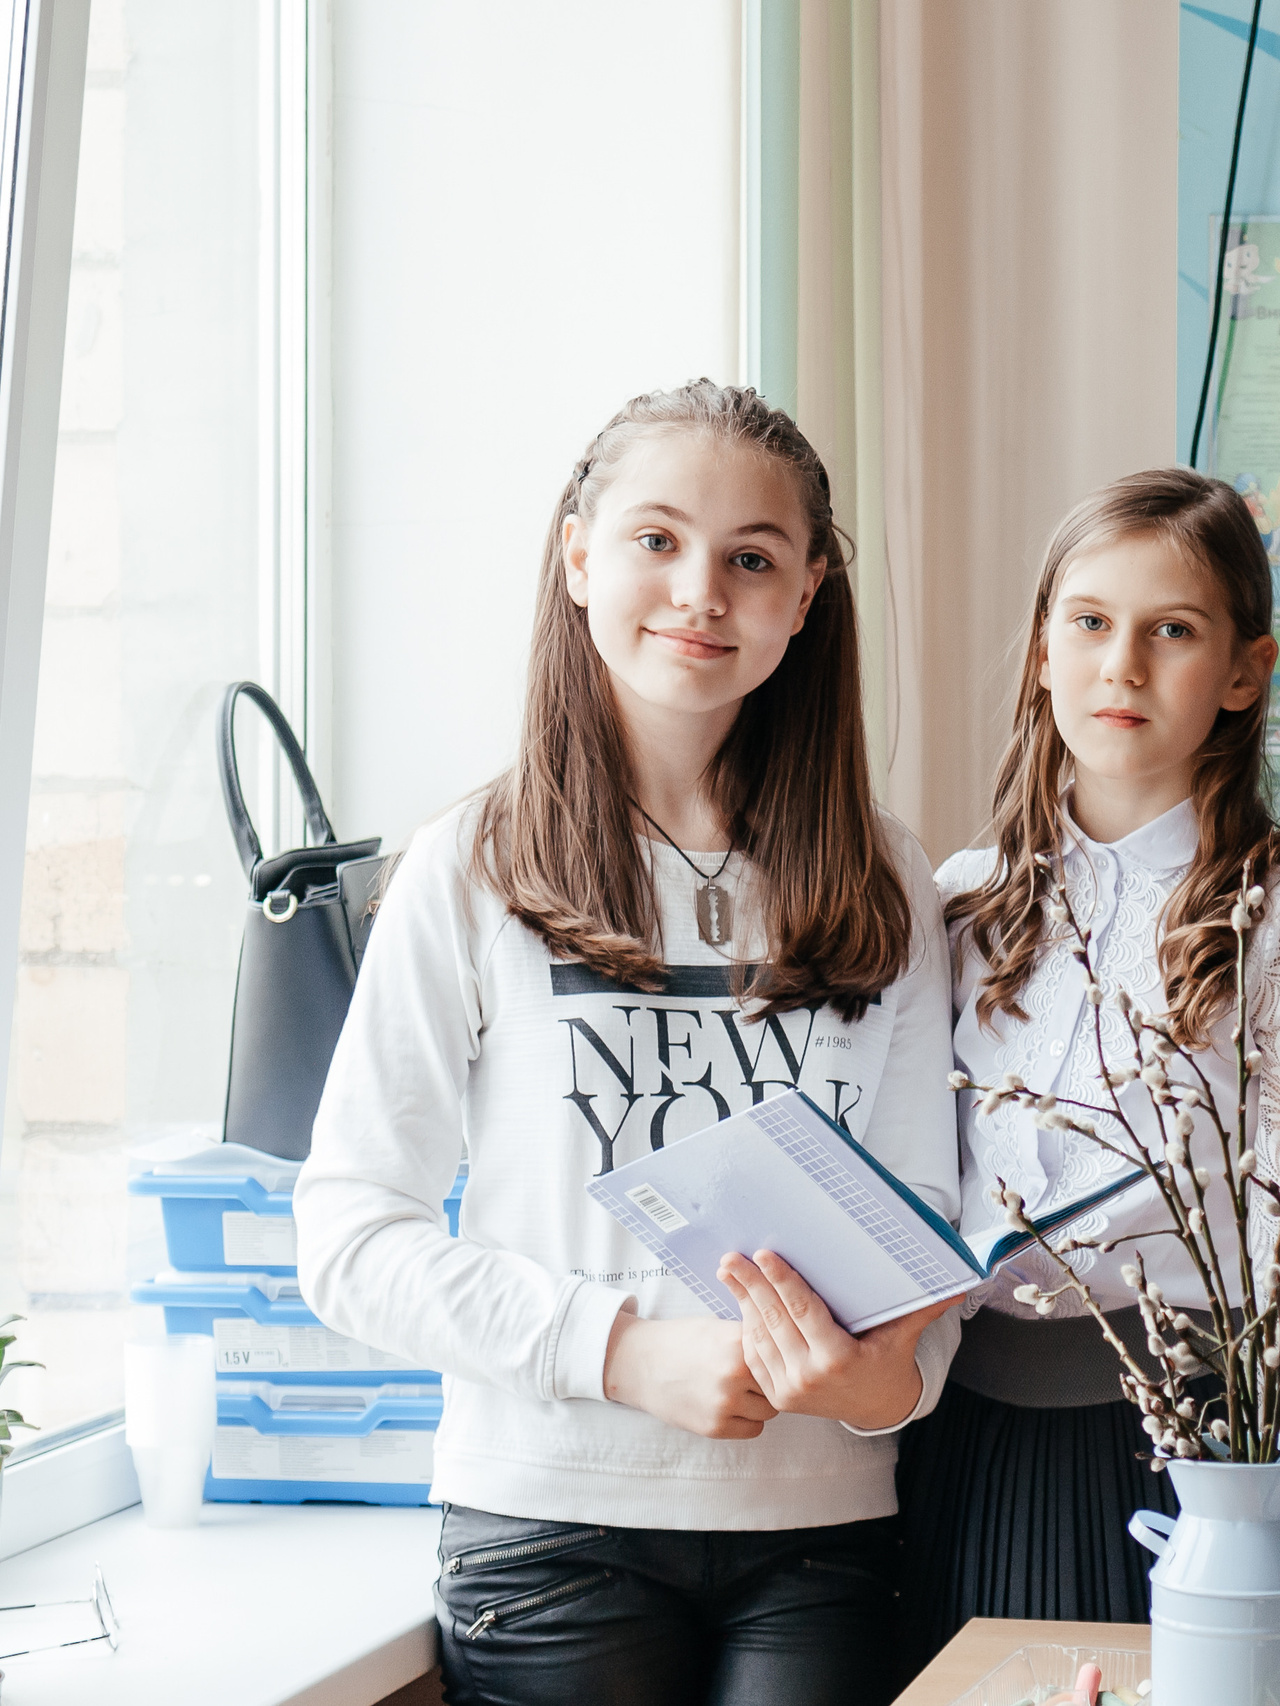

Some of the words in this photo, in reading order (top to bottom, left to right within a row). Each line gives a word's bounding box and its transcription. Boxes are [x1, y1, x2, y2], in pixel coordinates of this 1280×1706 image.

[815, 1035, 853, 1050] #1985
[558, 1005, 820, 1098] NEW
[598, 1270, 625, 1283] time
[628, 1266, 638, 1280] is
